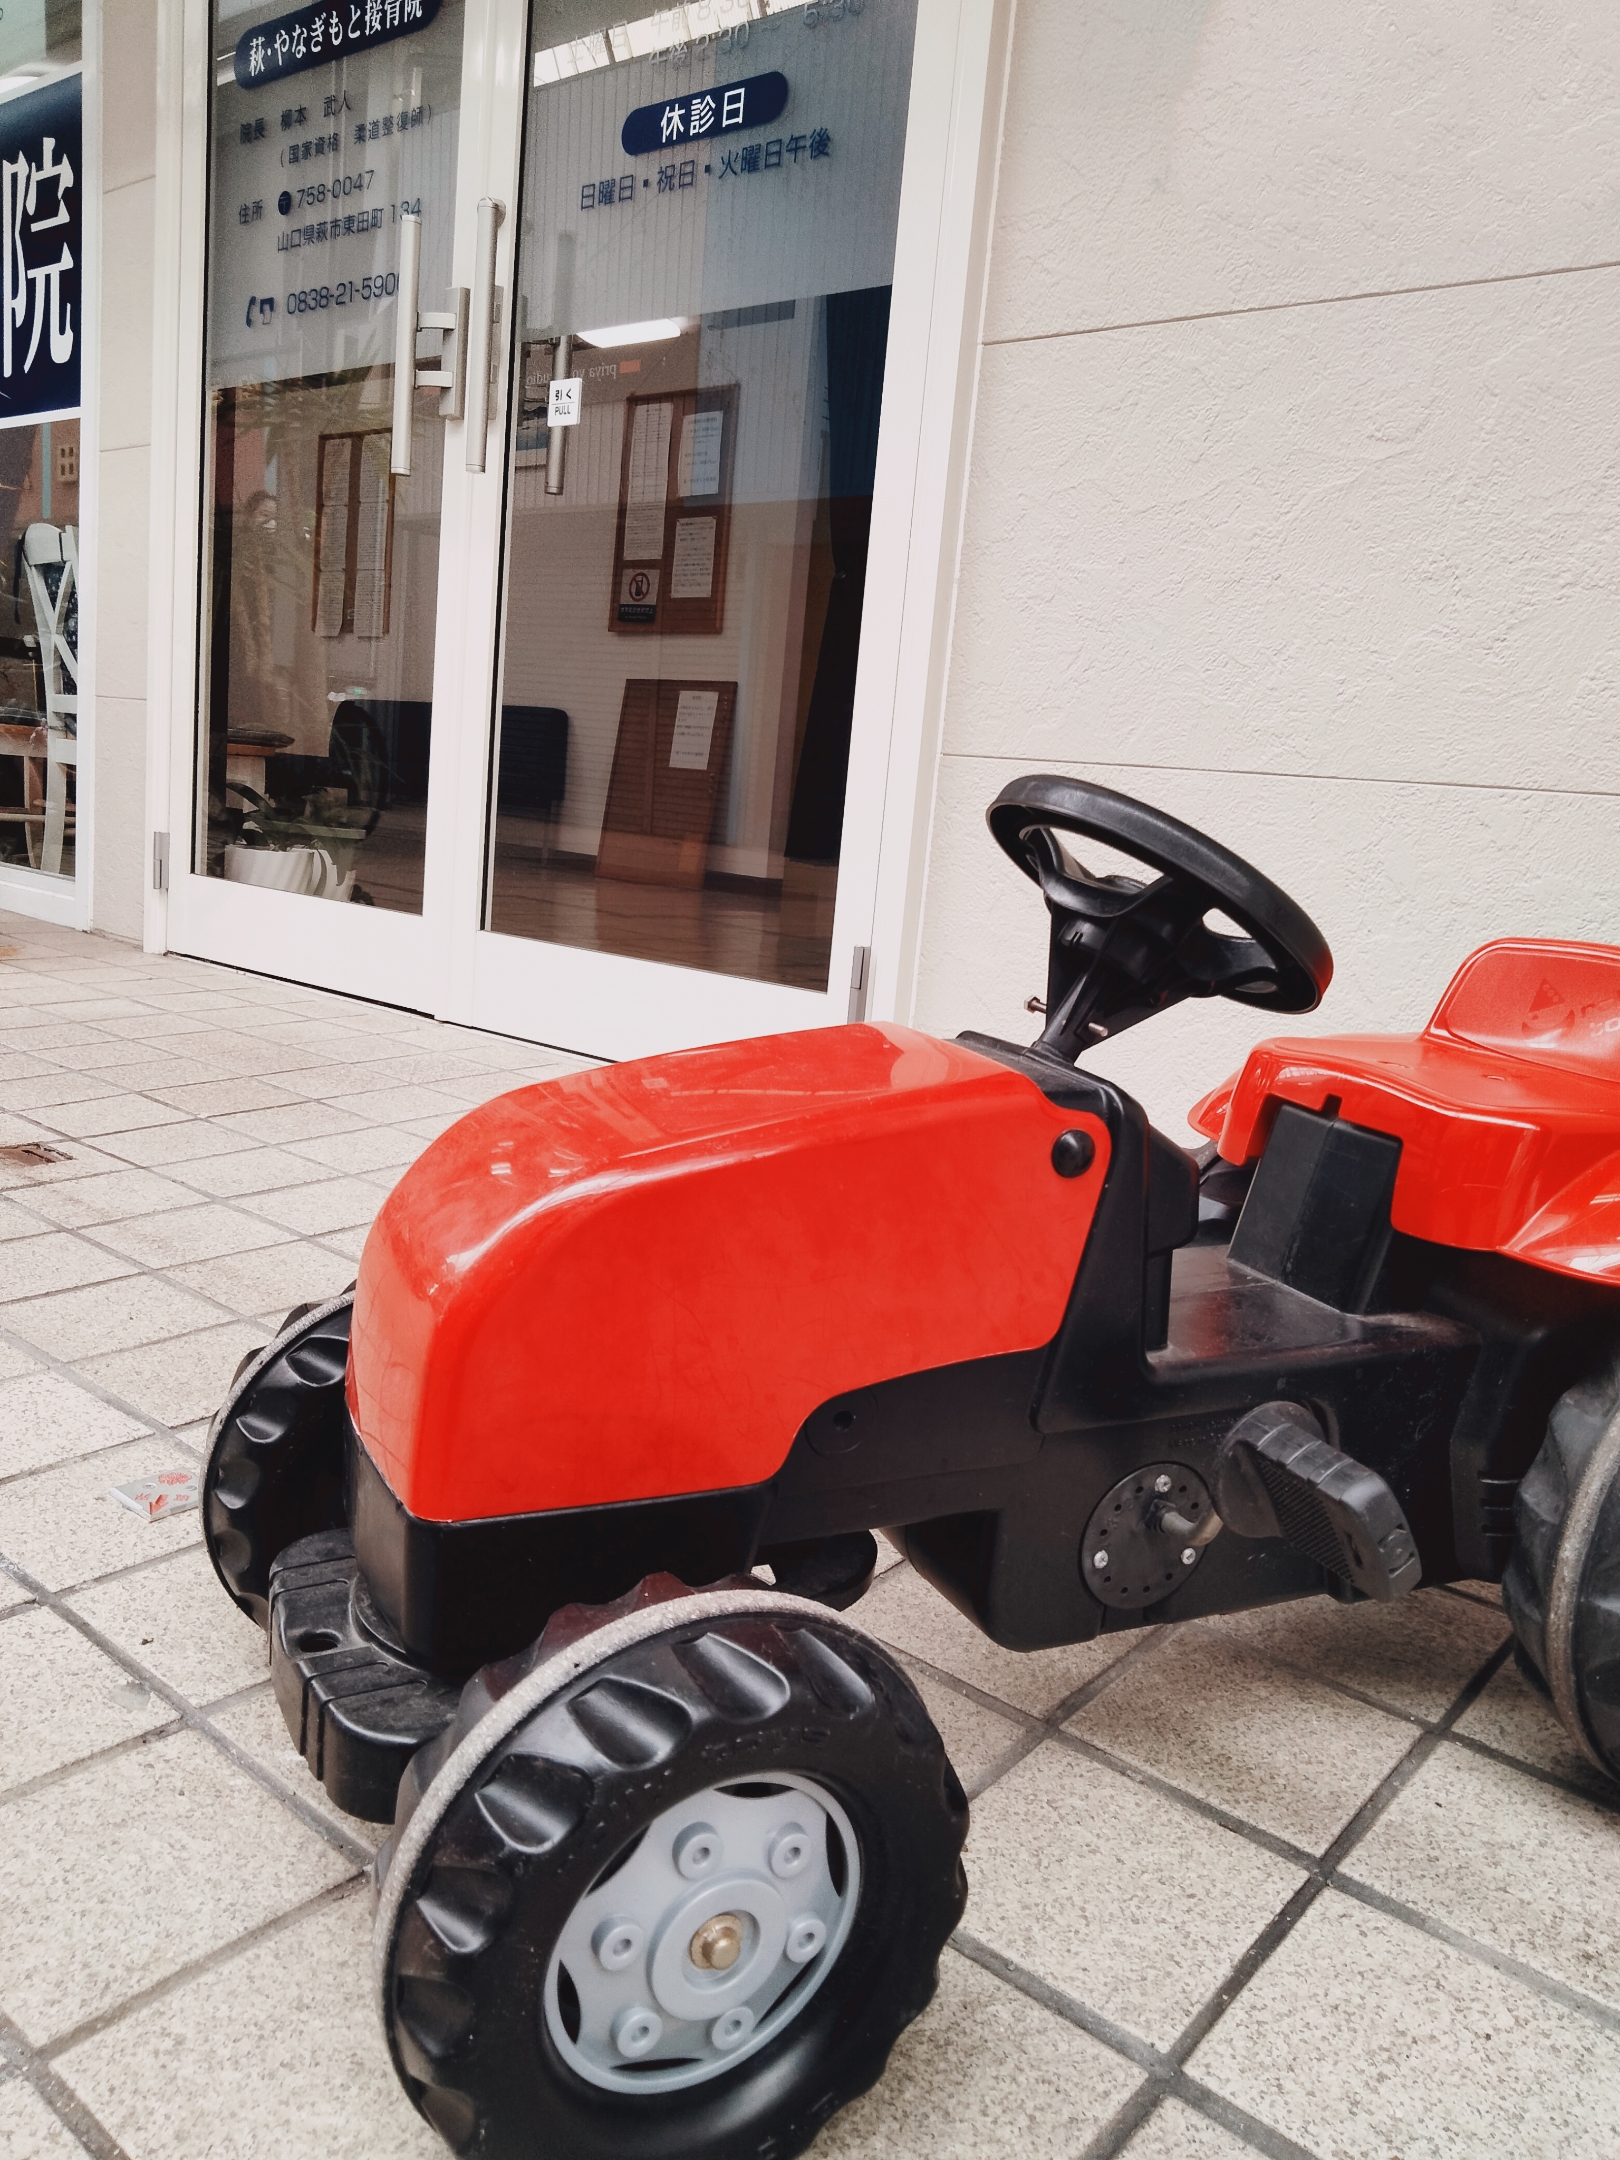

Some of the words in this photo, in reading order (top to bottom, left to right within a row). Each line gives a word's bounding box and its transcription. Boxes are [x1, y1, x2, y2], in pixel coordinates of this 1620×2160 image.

[660, 87, 746, 143] 休診日
[239, 198, 263, 225] 住所
[296, 169, 375, 208] 758-0047
[277, 208, 385, 253] 山口県萩市東田町
[3, 136, 74, 378] 院
[286, 272, 400, 315] 0838-21-590
[554, 405, 571, 416] PULL
[555, 387, 572, 402] 引く
